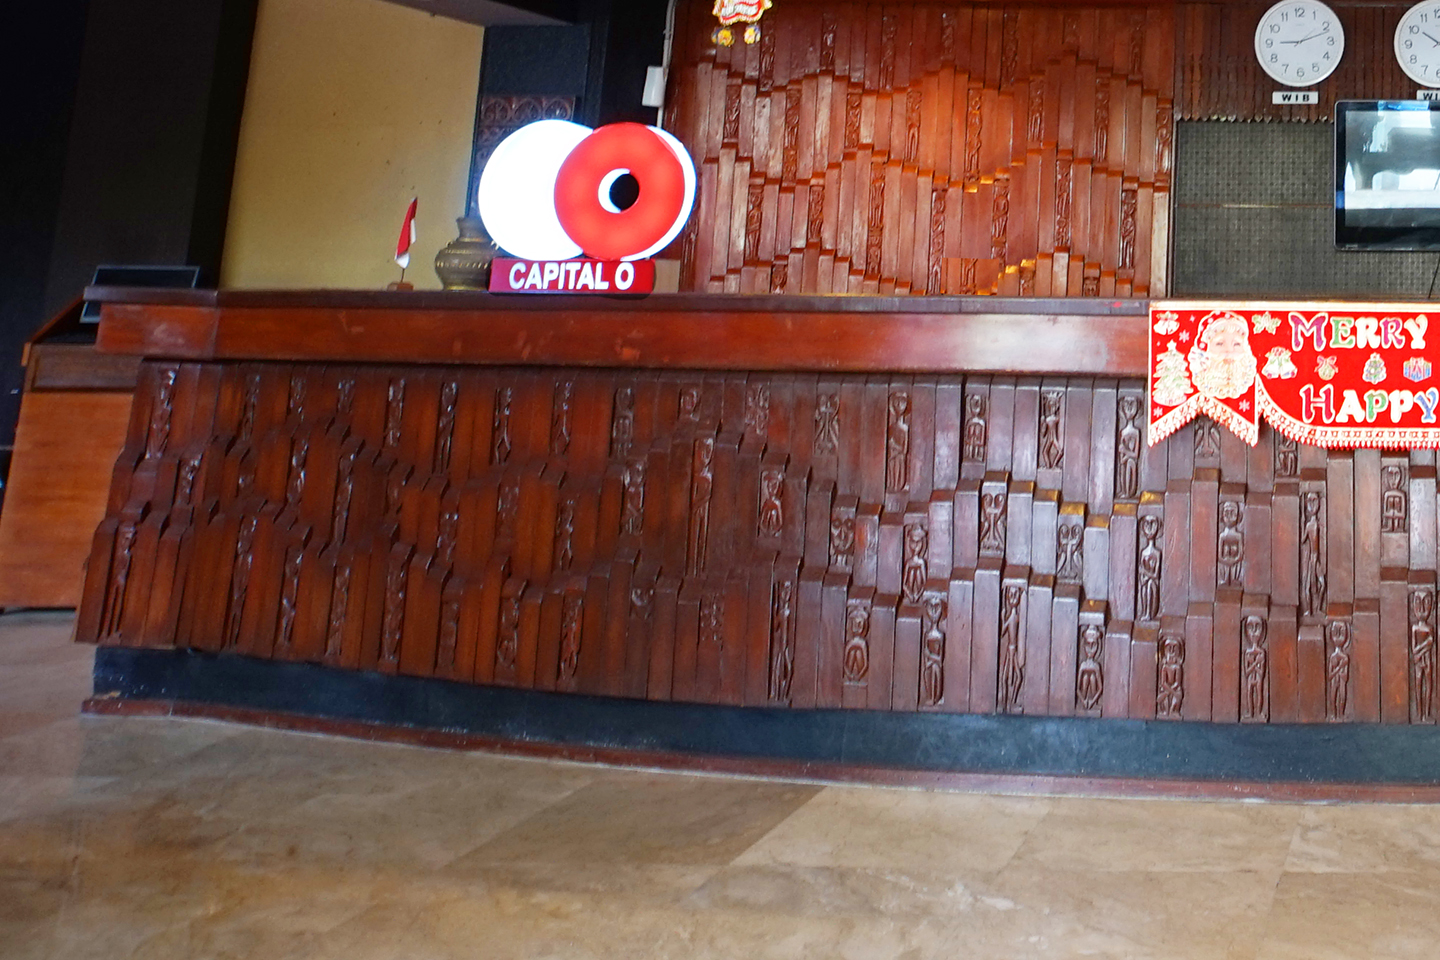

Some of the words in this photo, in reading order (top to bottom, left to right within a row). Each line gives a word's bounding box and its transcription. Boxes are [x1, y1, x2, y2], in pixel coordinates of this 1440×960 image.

[1281, 12, 1289, 22] 11
[1294, 7, 1305, 18] 12
[1312, 10, 1316, 20] 1
[1420, 13, 1428, 23] 11
[1269, 24, 1280, 34] 10
[1322, 21, 1330, 32] 2
[1408, 24, 1420, 35] 10
[1265, 38, 1274, 48] 9
[1326, 36, 1335, 46] 3
[1404, 39, 1413, 50] 9
[1270, 53, 1278, 63] 8
[1322, 51, 1330, 61] 4
[1409, 54, 1418, 64] 8
[1282, 64, 1290, 74] 7
[1312, 62, 1320, 72] 5
[1420, 64, 1429, 75] 7
[1296, 67, 1305, 78] 6
[1281, 94, 1310, 102] WIB
[508, 261, 610, 290] CAPITAL
[614, 261, 635, 291] O
[1288, 311, 1429, 352] MERRY
[1299, 383, 1440, 424] HAPPY
